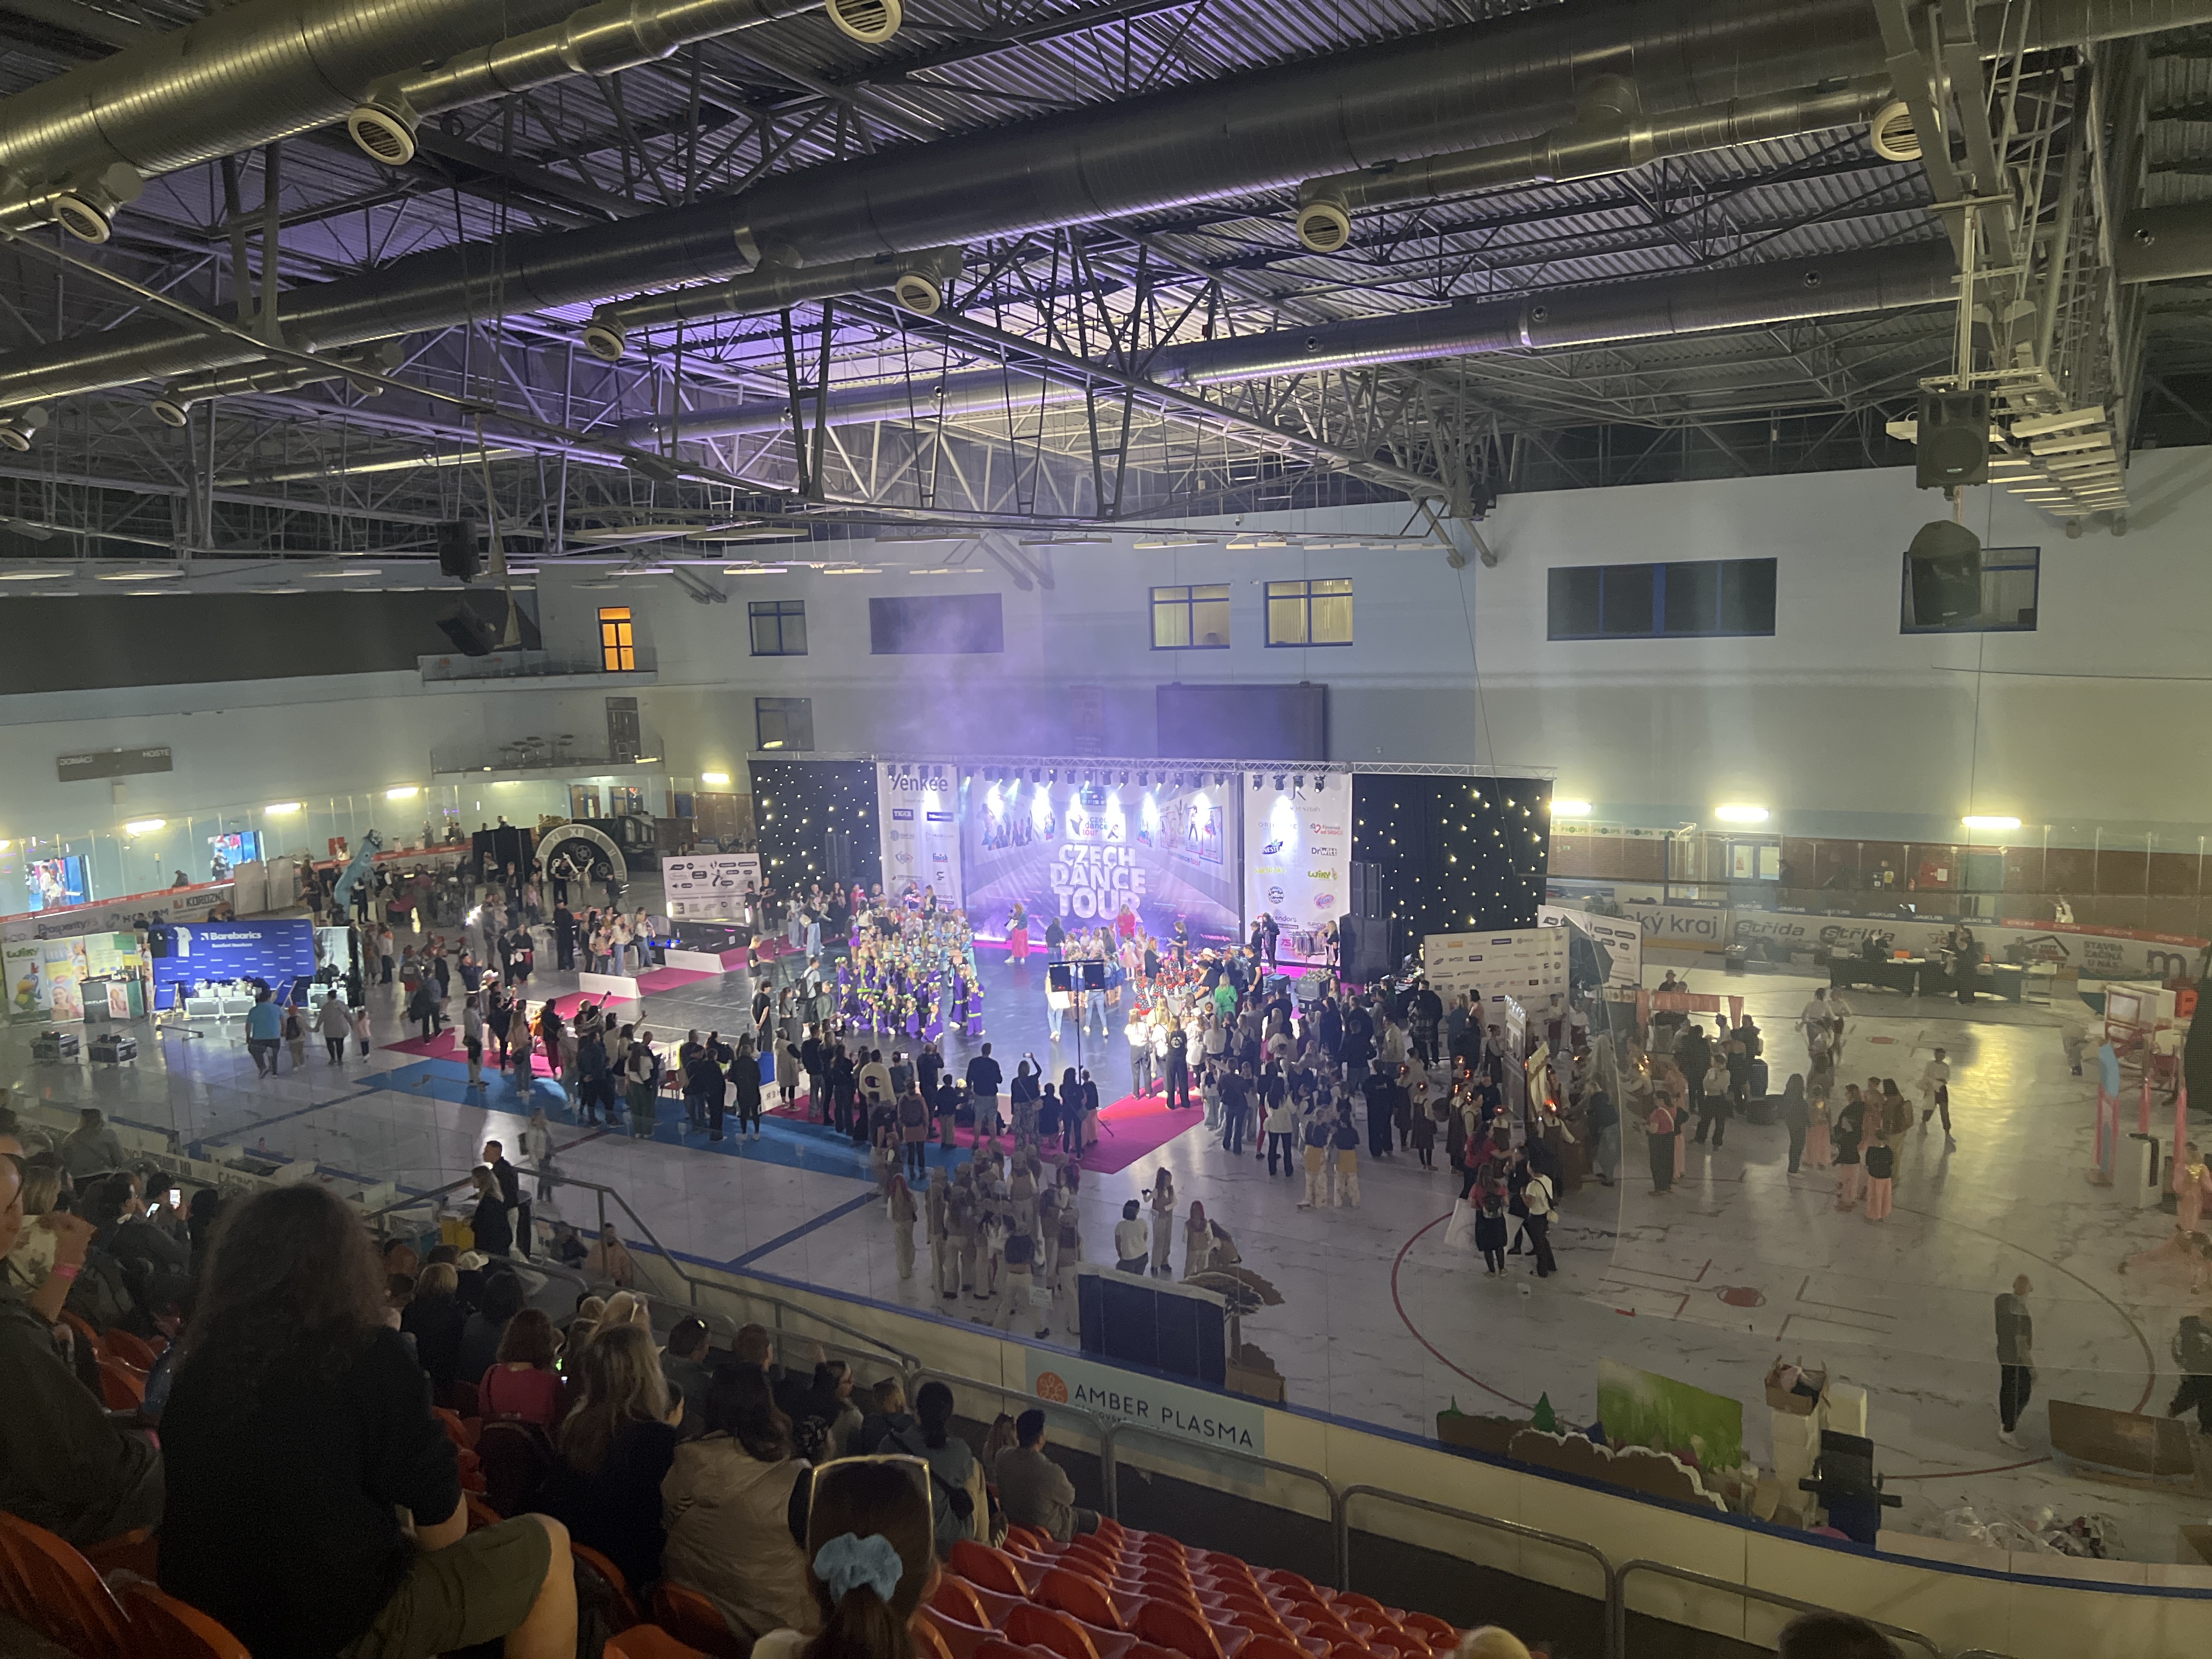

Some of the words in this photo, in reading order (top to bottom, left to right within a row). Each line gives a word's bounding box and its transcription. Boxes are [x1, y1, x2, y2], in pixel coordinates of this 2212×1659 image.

[890, 774, 948, 792] Yenkee
[569, 828, 584, 837] XII
[1085, 821, 1108, 830] dance
[1058, 843, 1136, 870] CZECH
[1190, 857, 1201, 866] tour
[1050, 861, 1146, 894] DANCE
[1053, 884, 1143, 923] TOUR
[211, 931, 262, 940] Barebarics
[1671, 914, 1717, 939] kraj
[2084, 940, 2124, 952] STAVBA
[1075, 1384, 1149, 1418] AMBER
[1162, 1407, 1253, 1448] PLASMA
